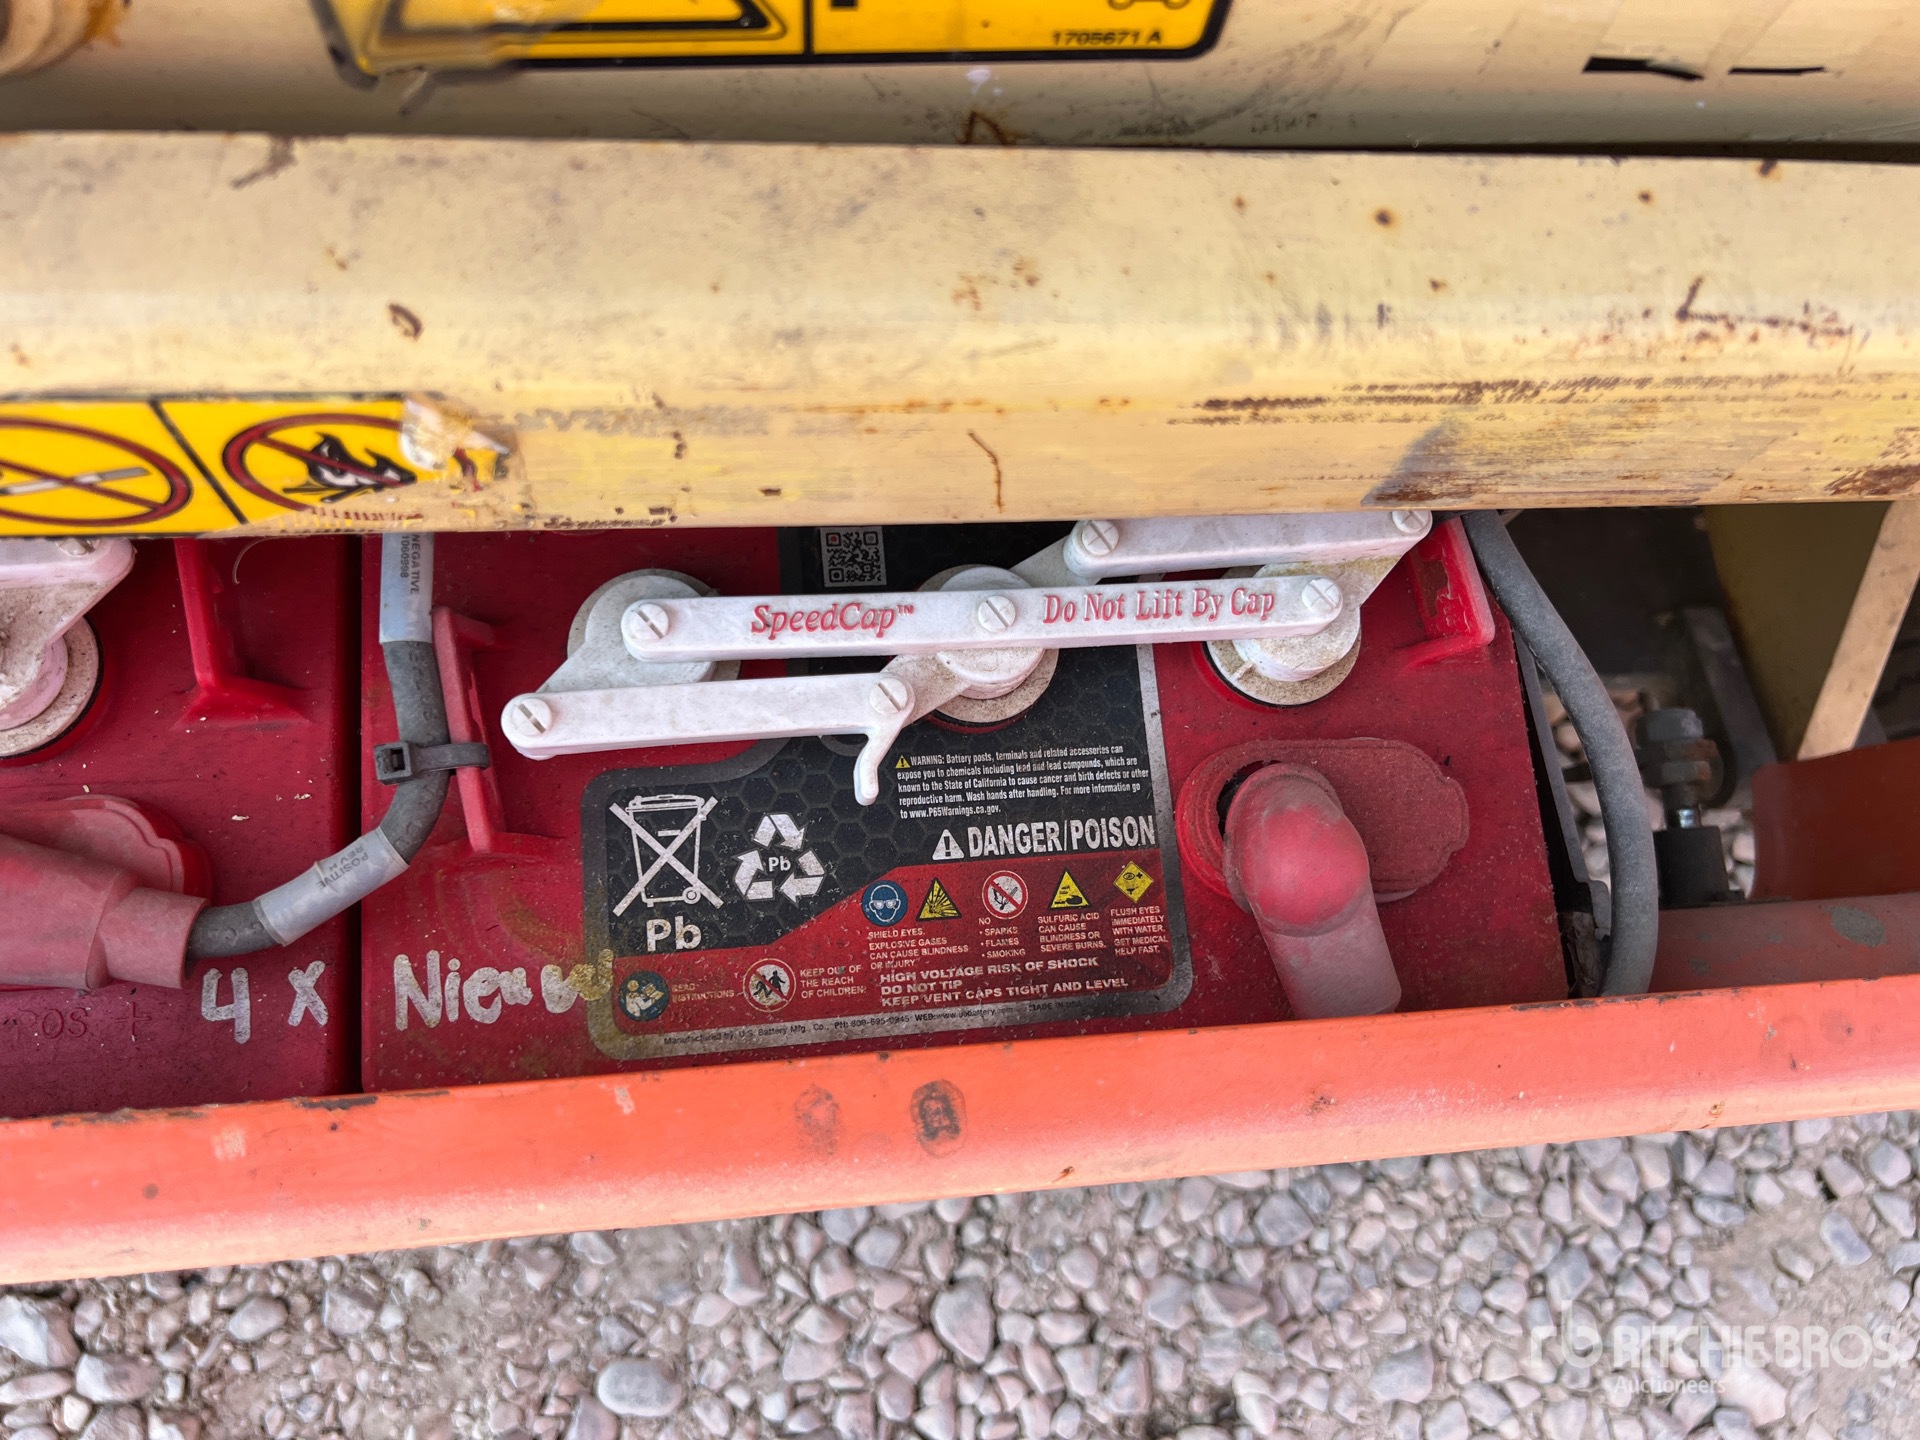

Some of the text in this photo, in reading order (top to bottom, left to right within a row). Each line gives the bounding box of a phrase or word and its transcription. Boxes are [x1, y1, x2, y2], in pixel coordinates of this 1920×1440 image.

[1146, 30, 1162, 45] A
[410, 534, 421, 595] NEGATIVE
[1043, 587, 1275, 624] Do Not Lift By Cap
[910, 745, 1124, 766] WARNING: Battery posts, terminals and related accessories can
[897, 756, 1138, 781] expose you to chemicals including lead and lead compounds, which are
[898, 768, 1149, 793] known to the State of California to cause cancer and birth defects or other
[899, 782, 1140, 808] reproductive harm. Wash hands after handling. For more information go
[900, 804, 1001, 820] to www.P65Warnings.ca.gov.
[967, 815, 1156, 858] DANGER/POISON
[316, 852, 368, 889] POSITIVE
[768, 856, 792, 872] Pb
[1110, 906, 1160, 916] FLUSH EYES
[978, 918, 991, 926] NO
[1038, 912, 1100, 924] SULFURIC ACID
[1112, 914, 1165, 926] IMMEDIATELY
[646, 916, 702, 952] Pb
[868, 929, 898, 939] SHIELD
[984, 926, 1018, 936] SPARKS
[1038, 922, 1086, 934] CAN CAUSE
[1112, 924, 1166, 936] WITH WATER.
[985, 938, 1020, 948] FLAMES
[1040, 931, 1100, 942] BLINDNESS OR
[1114, 935, 1169, 946] GET MEDICAL
[868, 937, 948, 951] EXPLOSIVE GASES
[1040, 940, 1106, 952] SEVERE BURNS.
[1138, 944, 1160, 954] FAST.
[870, 944, 969, 960] CAN CAUSE BLINDNESS
[986, 948, 1026, 958] SMOKING
[800, 968, 824, 978] KEEP
[849, 965, 862, 974] OF
[870, 961, 882, 970] OR
[880, 956, 1099, 984] HIGH VOLTAGE RISK OF SHOCK
[800, 976, 854, 988] THE REACH
[881, 979, 963, 996] DO NOT TIP
[801, 990, 814, 999] OF
[882, 977, 1128, 1007] KEEP VENT CAPS TIGHT AND LEVEL
[201, 967, 250, 1045] 4
